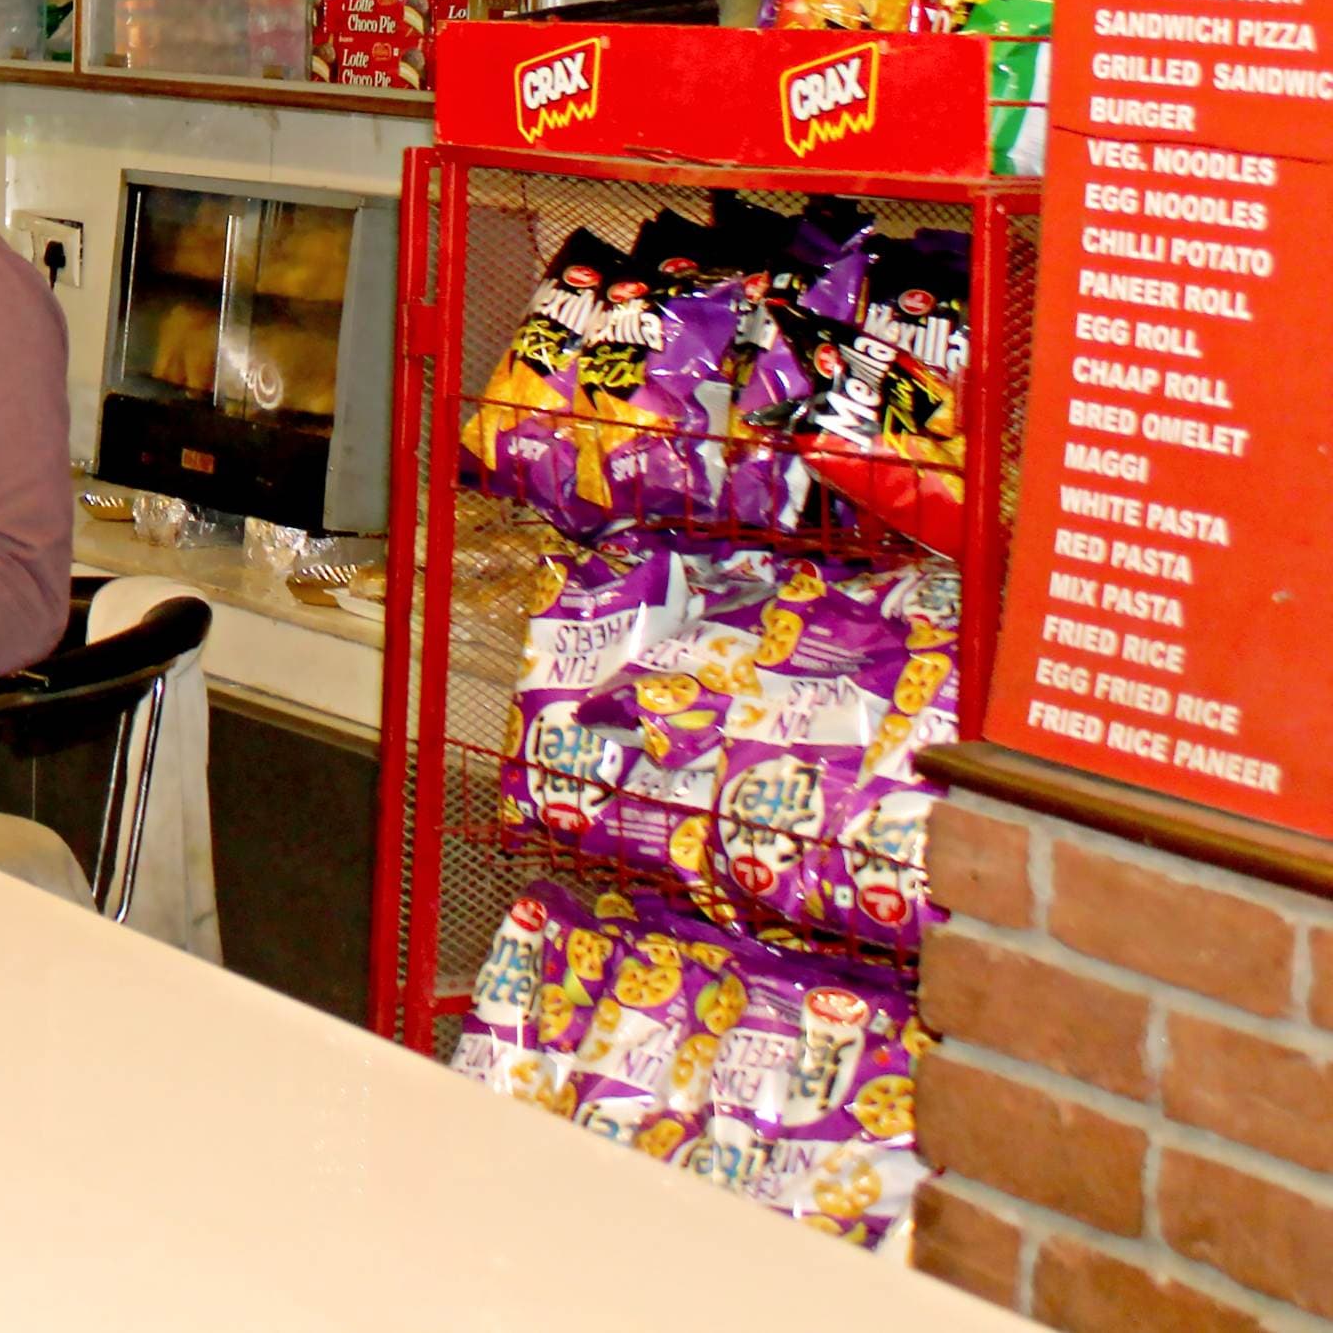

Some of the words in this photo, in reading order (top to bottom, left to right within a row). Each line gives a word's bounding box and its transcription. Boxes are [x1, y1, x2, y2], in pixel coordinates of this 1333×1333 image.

[347, 16, 378, 34] Choco
[379, 17, 396, 34] Pie
[1094, 8, 1234, 46] SANDWICH
[1237, 19, 1317, 52] PIZZA
[342, 48, 370, 67] Lotte
[523, 52, 589, 110] CRAX
[1092, 52, 1202, 88] GRILLED
[790, 57, 866, 121] CRAX
[1089, 96, 1196, 132] BURGER
[1087, 139, 1148, 171] VEG.
[1152, 146, 1278, 187] NOODLES
[1084, 182, 1140, 215] EGG
[1144, 189, 1268, 231] NOODLES
[1081, 226, 1166, 263] CHILLI
[1170, 237, 1274, 278] POTATO
[1079, 269, 1180, 310] PANEER
[1183, 284, 1253, 321] ROLL
[1075, 312, 1131, 346] EGG
[1134, 321, 1203, 359] ROLL
[1072, 356, 1161, 394] CHAAP
[1164, 371, 1233, 409] ROLL
[1068, 399, 1138, 436] BRED
[1142, 412, 1250, 457] OMELET
[1064, 442, 1149, 483] MAGGI
[1060, 485, 1143, 527] WHITE
[1146, 503, 1230, 546] PASTA
[1054, 528, 1107, 564] RED
[1110, 541, 1193, 584] PASTA
[1049, 571, 1098, 607] MIX
[1101, 583, 1184, 628] PASTA
[1042, 614, 1119, 656] FRIED
[1122, 633, 1185, 674] RICE
[1035, 657, 1090, 695] EGG
[1094, 672, 1172, 715] FRIED
[1175, 693, 1241, 735] RICE
[1027, 700, 1104, 744] FRIED
[1107, 721, 1170, 763] RICE
[1173, 739, 1282, 794] PANEER
